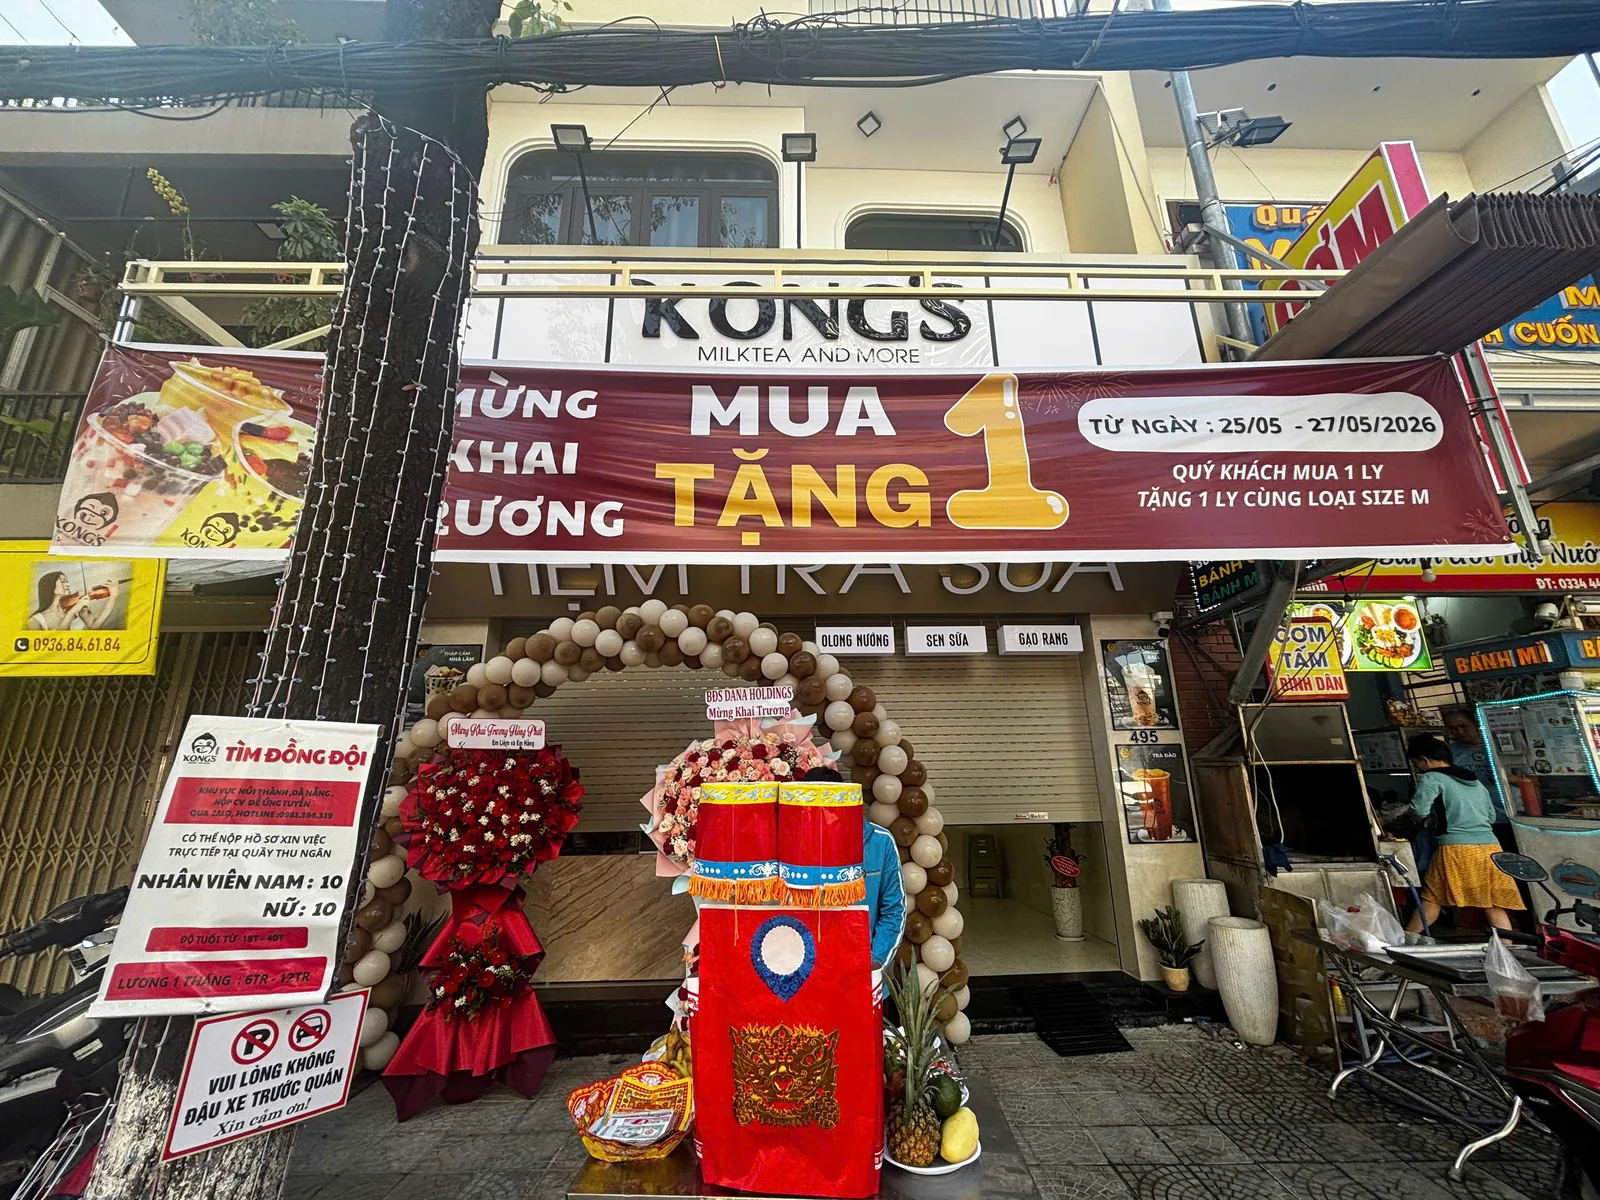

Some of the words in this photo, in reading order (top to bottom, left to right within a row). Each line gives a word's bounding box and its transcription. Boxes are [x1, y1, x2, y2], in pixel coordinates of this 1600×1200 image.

[630, 275, 972, 341] KONG'S
[1514, 314, 1600, 344] CUỐN
[698, 346, 791, 363] MILKTEA
[801, 347, 850, 363] AND
[856, 348, 920, 364] MORE
[690, 385, 896, 437] MUA
[1089, 415, 1124, 434] TỪ
[1132, 415, 1197, 434] NGÀY
[1218, 417, 1282, 434] 25/05
[1307, 416, 1437, 433] 27/05/2026
[943, 372, 1071, 530] 1
[1173, 460, 1215, 483] QUÝ
[1220, 460, 1286, 480] KHÁCH
[1293, 464, 1339, 480] MUA
[1344, 464, 1353, 480] 1
[1362, 464, 1384, 480] LY
[655, 448, 931, 546] TẶNG
[1138, 487, 1191, 511] TẶNG
[1199, 491, 1208, 507] 1
[1216, 491, 1239, 507] LY
[1244, 487, 1301, 507] CÙNG
[1308, 490, 1356, 510] LOẠI
[1362, 489, 1405, 506] SIZE
[1411, 489, 1430, 505] M
[55, 516, 106, 546] KONG'S
[1559, 578, 1587, 589] 0334
[821, 634, 852, 648] OLONG
[857, 631, 889, 648] NƯỚNG
[926, 633, 946, 647] SEN
[949, 631, 969, 647] SỮA
[1018, 632, 1038, 649] GẠO
[1042, 632, 1068, 646] RANG
[1274, 625, 1327, 643] CƠM
[33, 637, 120, 652] 0936.84.61.84
[1283, 645, 1329, 668] TẤM
[1455, 651, 1513, 674] BÁNH
[1517, 640, 1550, 665] MÌ
[1280, 674, 1313, 692] BÌNH
[1316, 673, 1343, 692] DÂN
[706, 689, 722, 702] BĐS
[725, 689, 747, 702] DANA
[750, 686, 792, 701] HOLDINGS
[709, 706, 733, 719] Mừng
[736, 706, 754, 717] Khai
[757, 705, 789, 717] Trương
[1131, 730, 1158, 743] 495
[226, 740, 262, 762] TÌM
[264, 738, 325, 764] ĐỒNG
[328, 744, 367, 771] ĐỘI
[219, 788, 236, 796] VỰC
[238, 786, 256, 794] NÚI
[258, 787, 288, 796] THÀNH
[190, 809, 208, 817] QUA
[182, 832, 197, 843] CÓ
[200, 832, 219, 843] THỂ
[219, 833, 242, 846] NỘP
[244, 833, 261, 844] HỒ
[264, 835, 279, 844] SƠ
[281, 836, 300, 844] XIN
[303, 834, 326, 846] VIỆC
[169, 847, 197, 858] TRỰC
[200, 846, 220, 857] TIẾP
[223, 849, 238, 859] TẠI
[242, 846, 273, 858] QUẦY
[276, 849, 297, 858] THU
[300, 848, 331, 858] NGÂN
[137, 868, 203, 890] NHÂN
[206, 868, 250, 890] VIÊN
[254, 875, 303, 890] NAM
[320, 875, 343, 889] 10
[312, 902, 337, 917] 10
[180, 935, 193, 945] ĐỘ
[223, 934, 237, 943] TỪ
[117, 976, 168, 989] LƯƠNG
[173, 976, 178, 987] 1
[183, 973, 231, 987] THÁNG
[246, 974, 269, 985] 6TR
[280, 972, 310, 983] 12TR
[208, 1075, 236, 1095] VUI
[239, 1063, 282, 1089] LÒNG
[286, 1049, 336, 1077] KHÔNG
[183, 1104, 219, 1128] ĐẬU
[223, 1095, 246, 1116] XE
[251, 1080, 301, 1106] TRƯỚC
[304, 1068, 343, 1093] QUÁN
[214, 1118, 245, 1138] Xin
[249, 1109, 282, 1127] cảm
[285, 1098, 311, 1119] ơn!
